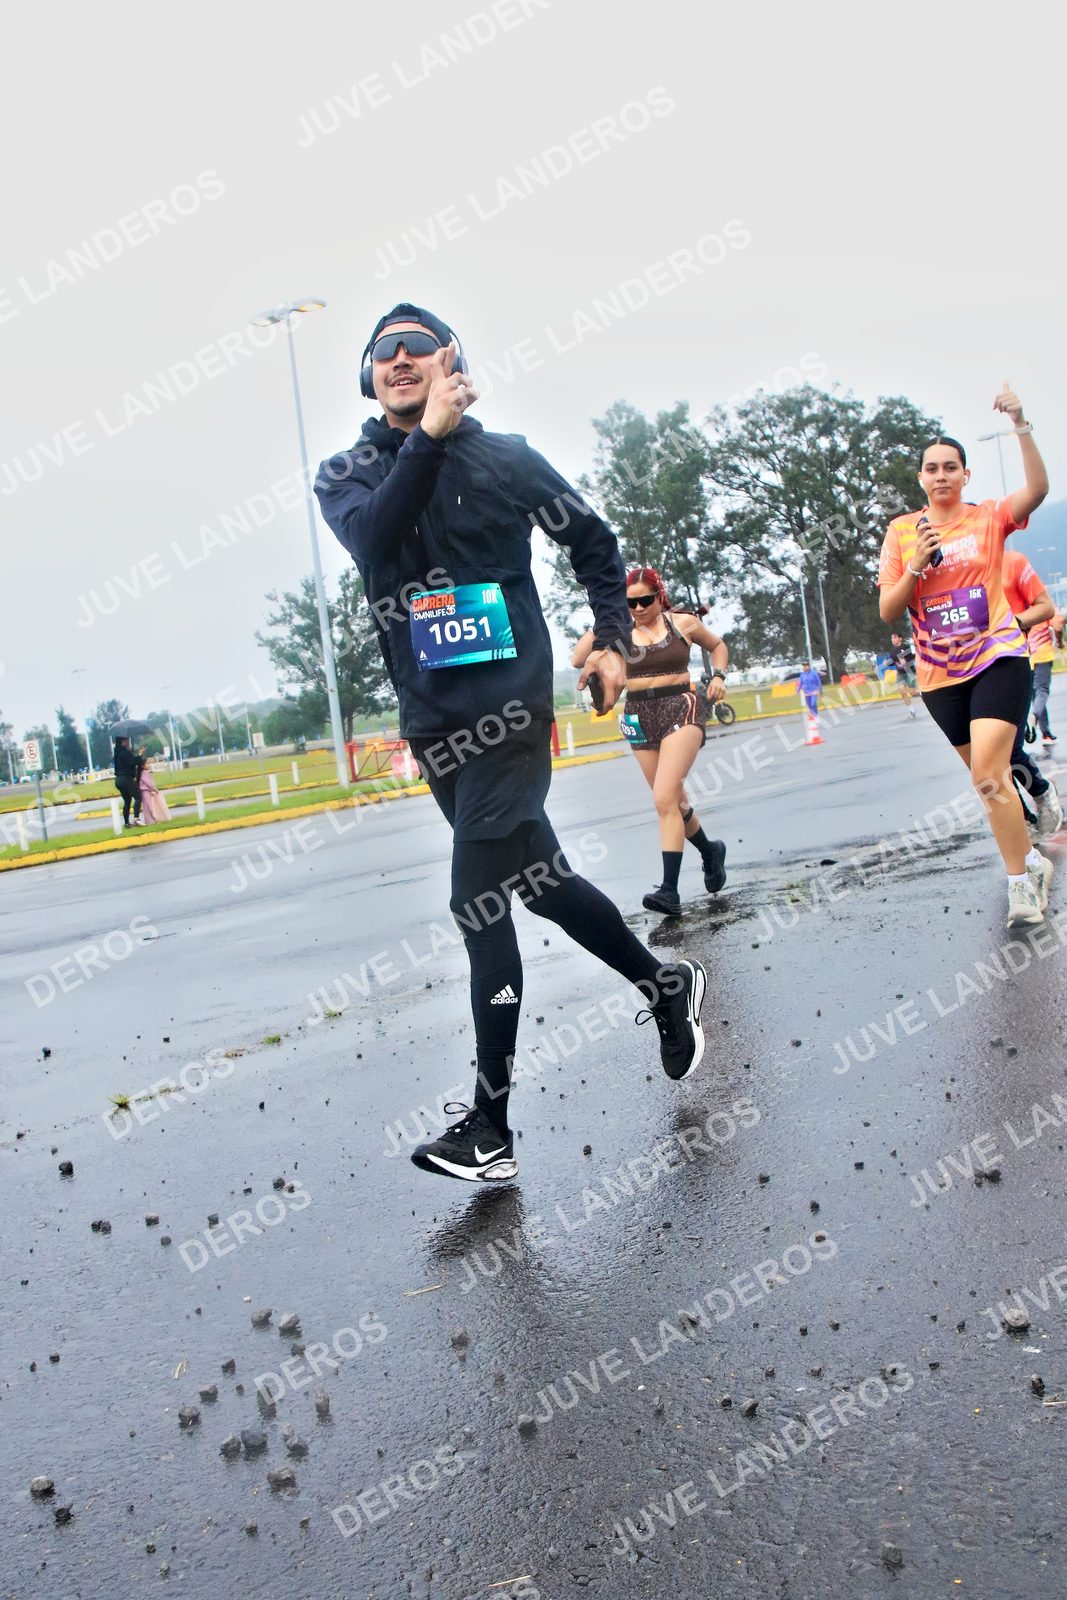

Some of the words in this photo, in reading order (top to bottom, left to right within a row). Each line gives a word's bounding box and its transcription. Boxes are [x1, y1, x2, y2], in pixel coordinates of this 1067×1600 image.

[412, 594, 455, 612] CARRERA
[481, 589, 498, 605] 10K
[940, 606, 970, 626] 265
[428, 616, 491, 645] 1051
[490, 997, 518, 1005] adidas
